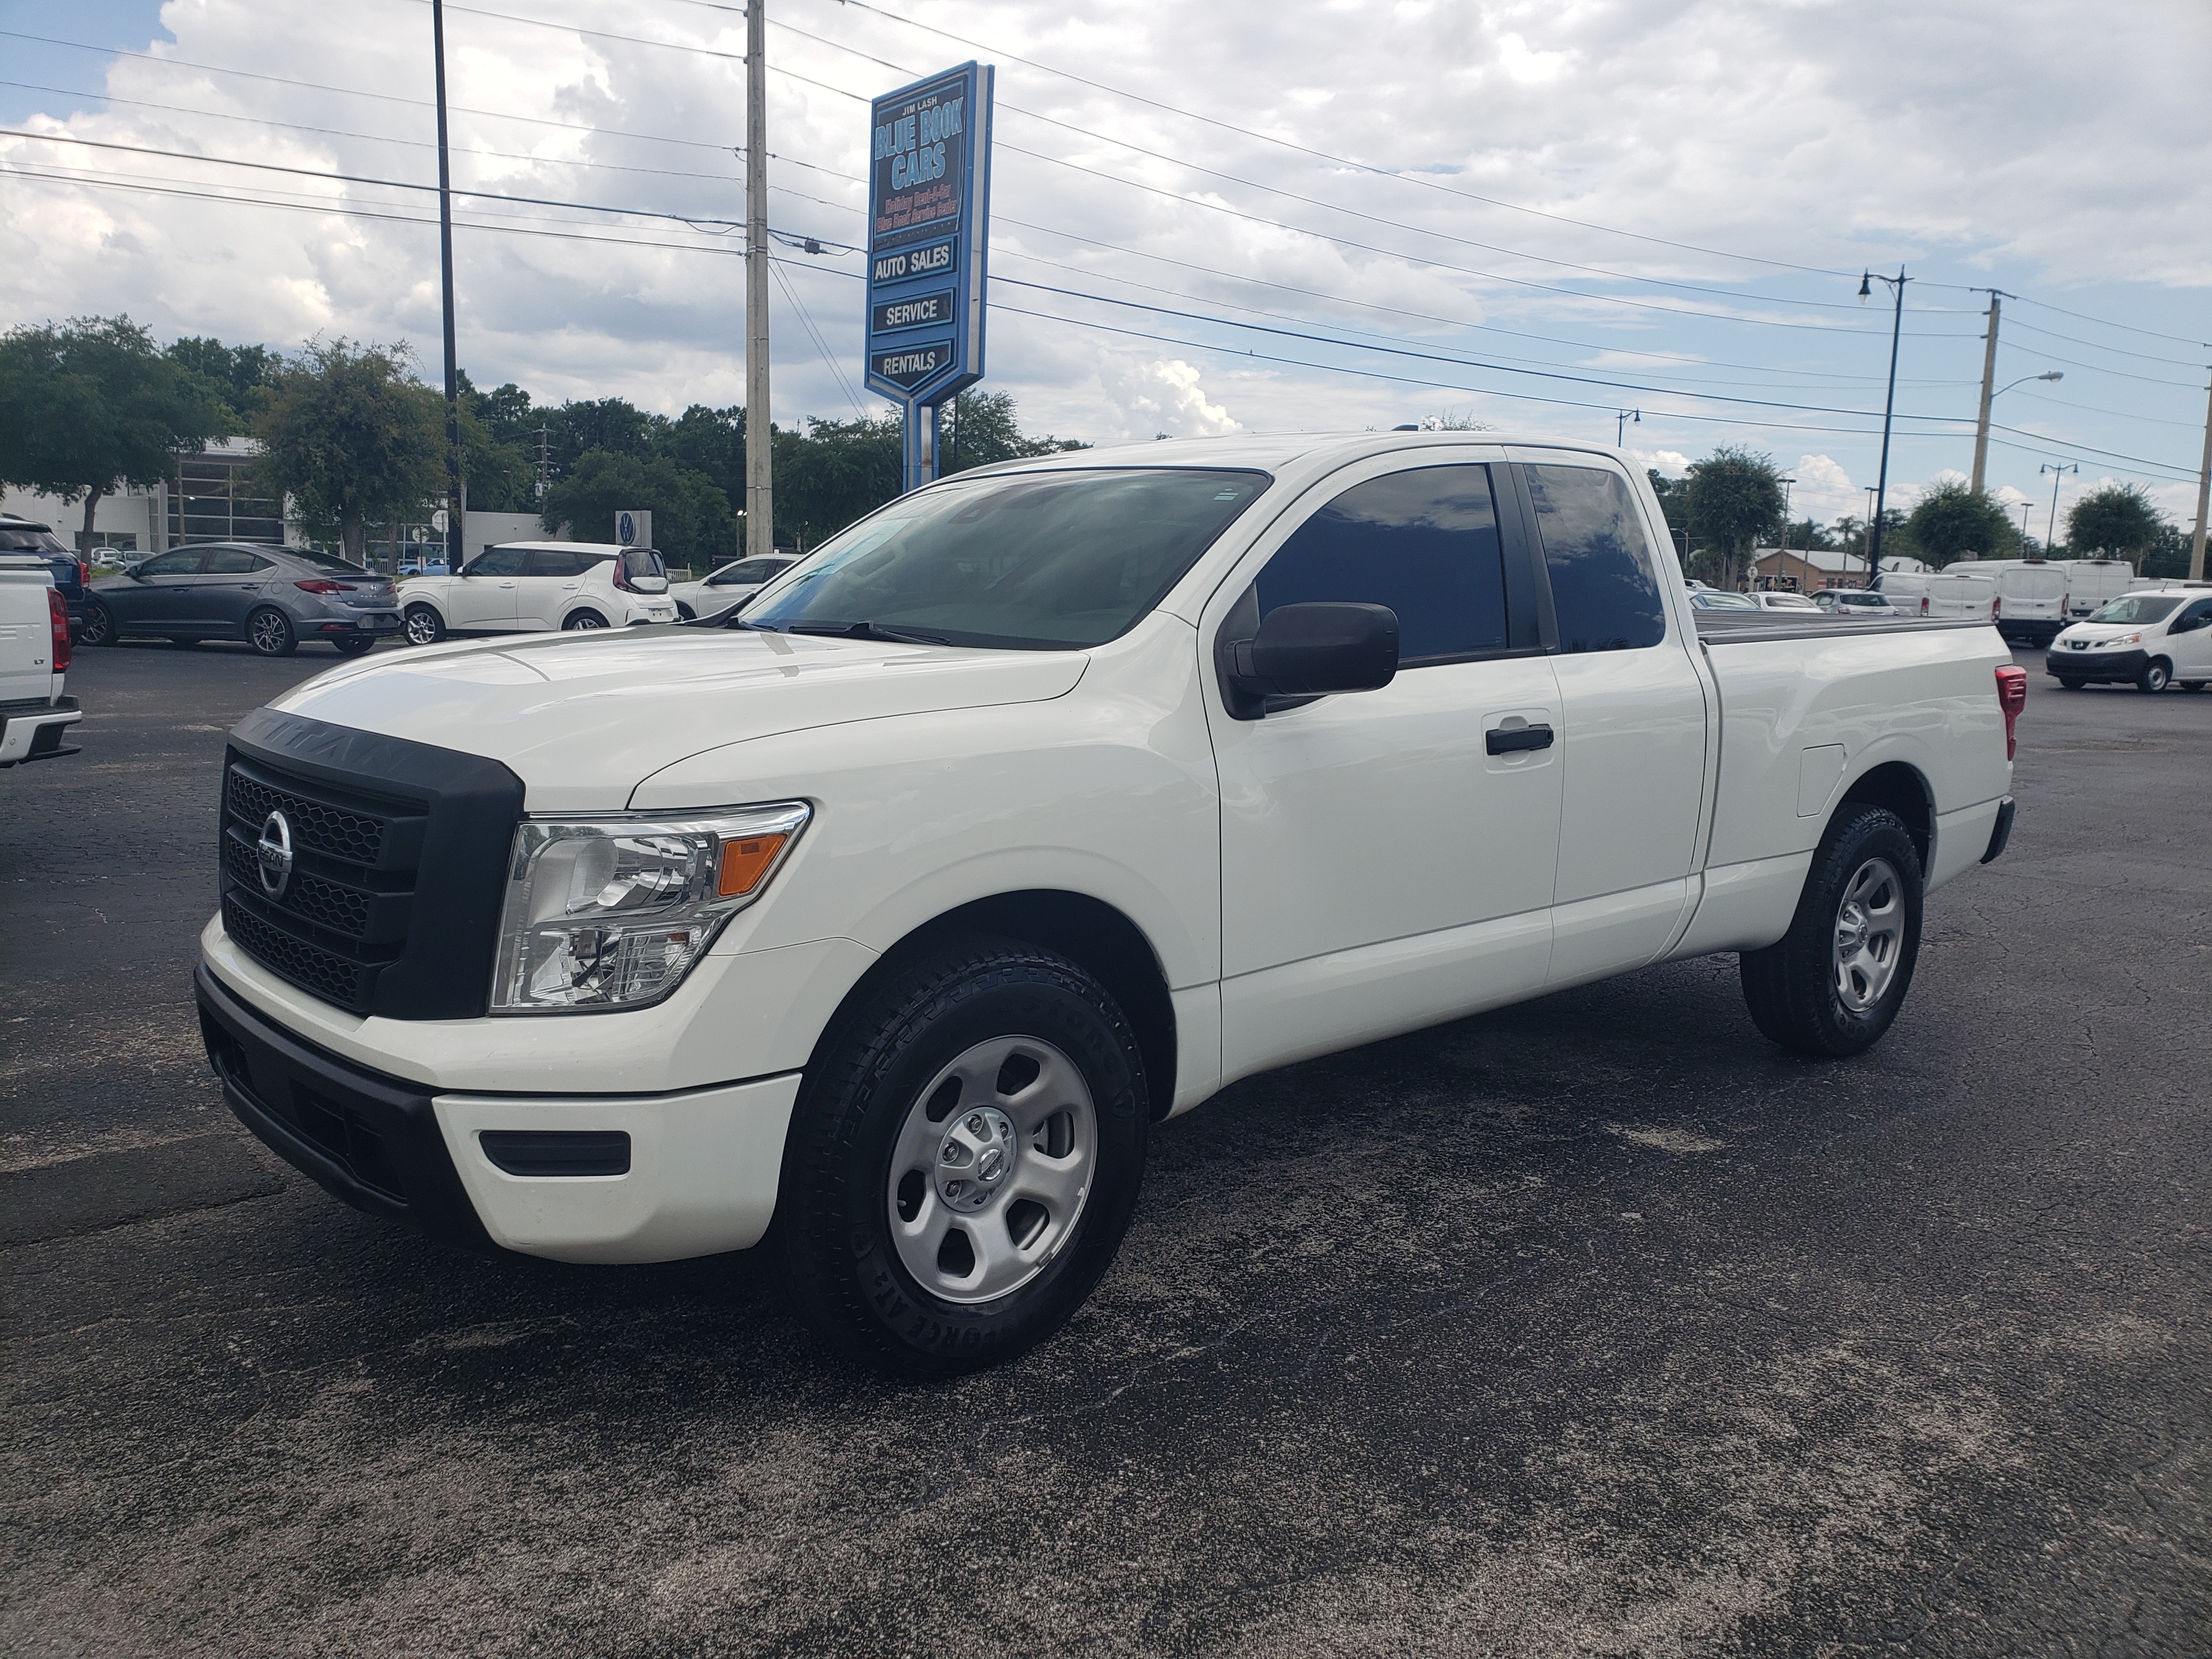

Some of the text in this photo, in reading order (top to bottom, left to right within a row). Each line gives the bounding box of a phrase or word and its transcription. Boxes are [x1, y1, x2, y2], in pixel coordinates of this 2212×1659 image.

[902, 96, 937, 116] JIM LASH
[875, 97, 964, 160] BLUE BOOK
[892, 142, 946, 190] CARS
[877, 199, 957, 233] Blue Book Service Center
[885, 196, 913, 214] Holiday
[875, 245, 950, 280] AUTO SALES
[887, 299, 938, 325] SERVICE
[883, 351, 936, 376] RENTALS
